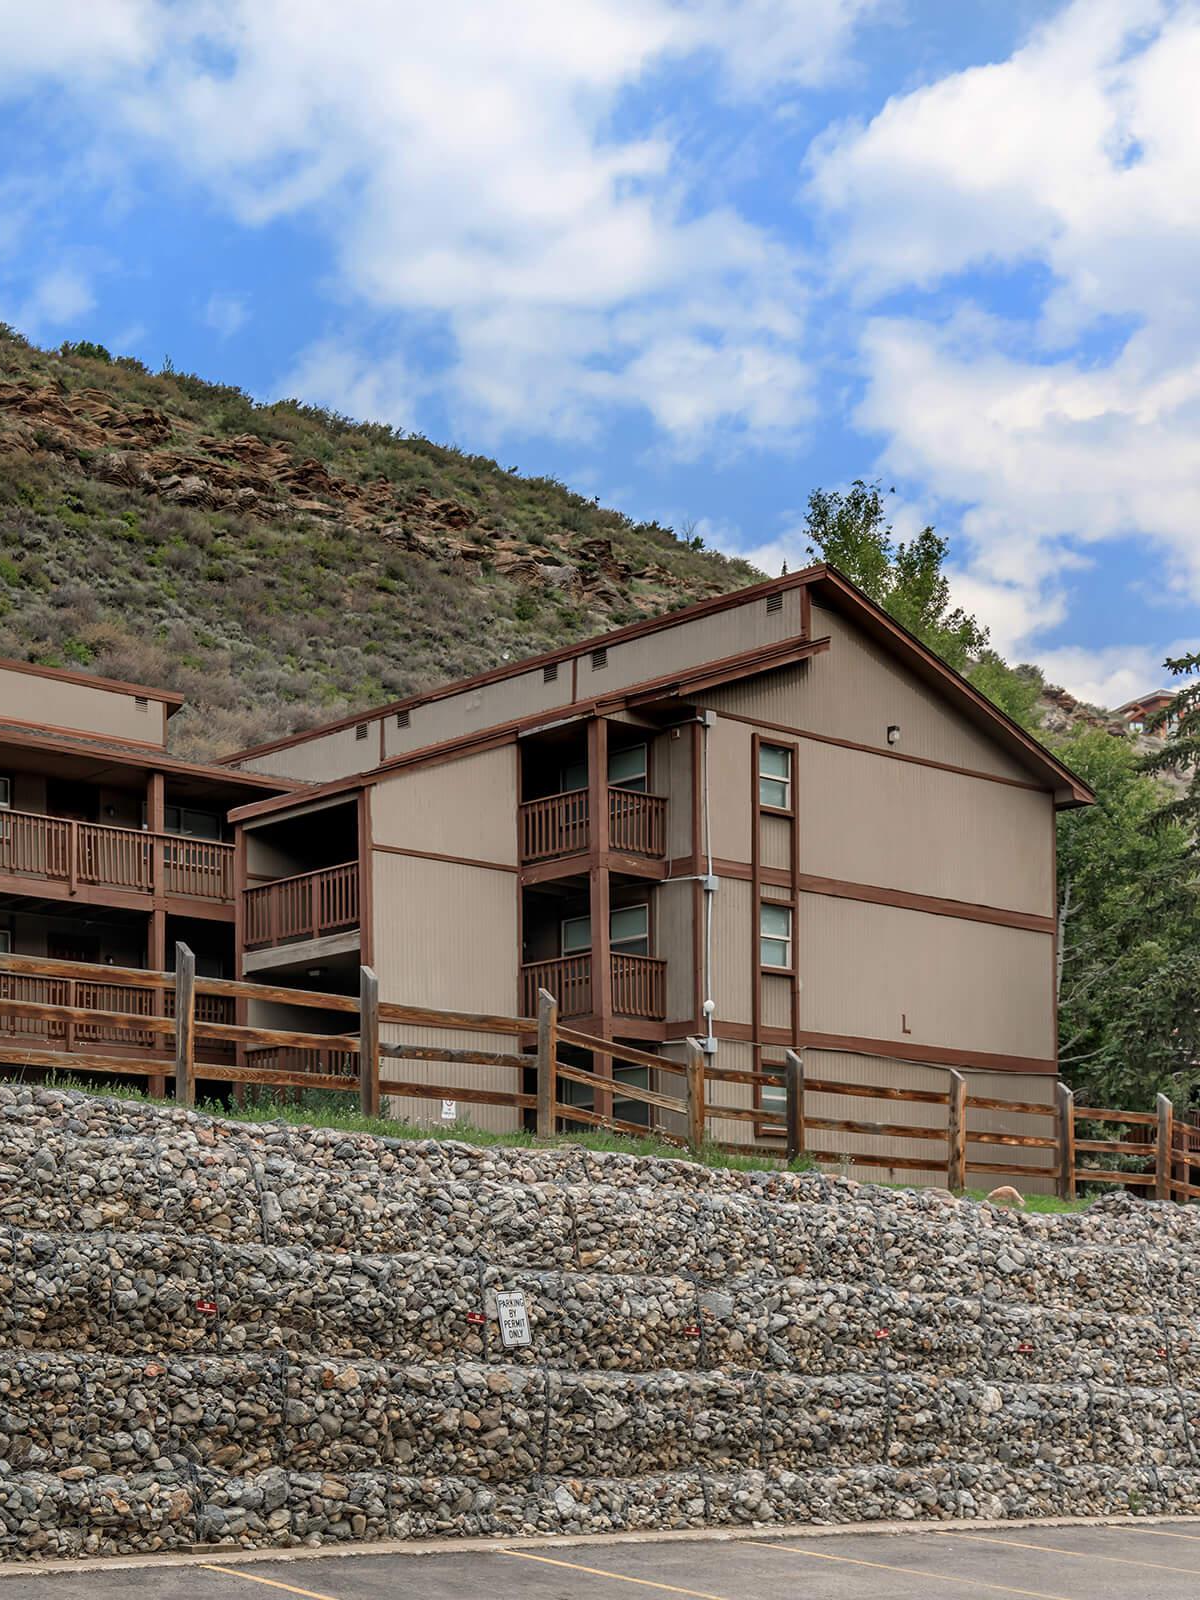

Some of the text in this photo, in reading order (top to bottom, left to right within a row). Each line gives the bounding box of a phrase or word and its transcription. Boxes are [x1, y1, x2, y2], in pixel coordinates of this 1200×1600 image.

[902, 1013, 912, 1035] L
[498, 1298, 524, 1307] PARKING
[509, 1309, 516, 1318] BY
[504, 1319, 524, 1328] PERMIT
[509, 1330, 523, 1339] ONLY
